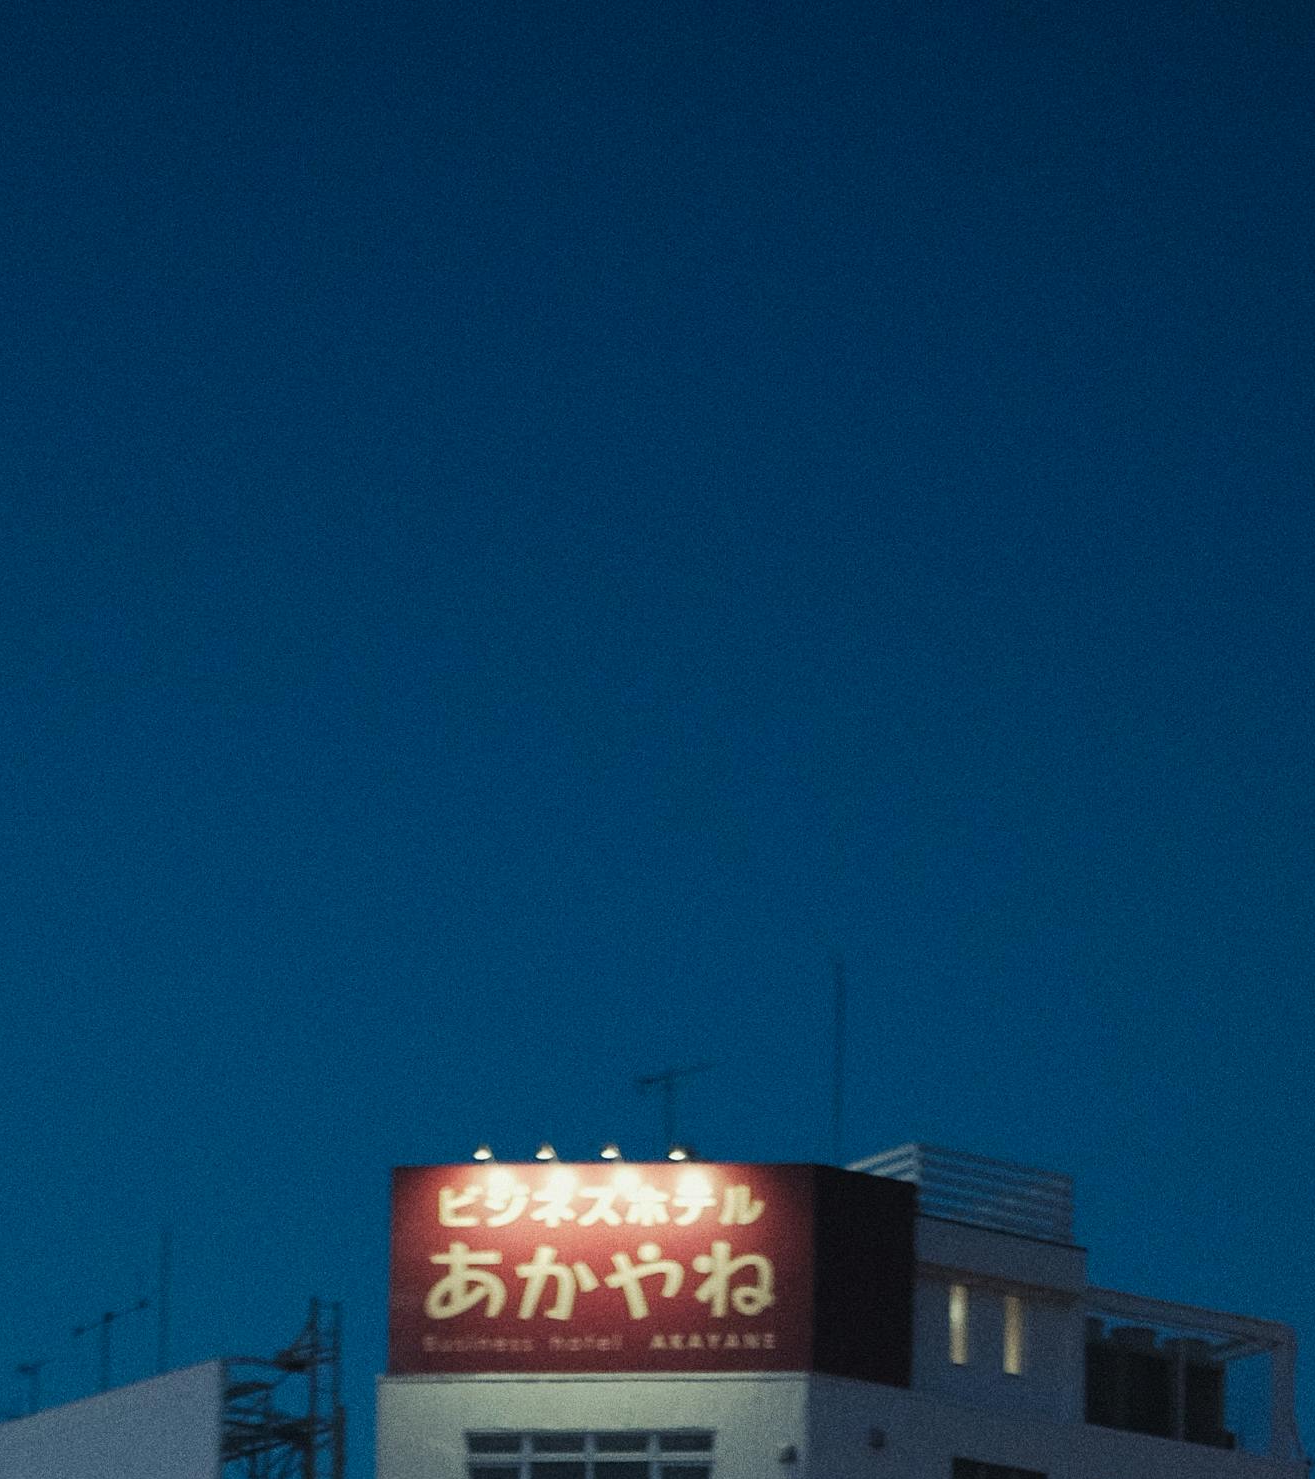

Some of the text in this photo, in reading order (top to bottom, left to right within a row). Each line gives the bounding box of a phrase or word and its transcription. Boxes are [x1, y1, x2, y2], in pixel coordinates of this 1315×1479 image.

[438, 1183, 766, 1227] ビジネスホテル
[424, 1241, 776, 1320] あかやね
[648, 1333, 776, 1351] AKAYANE
